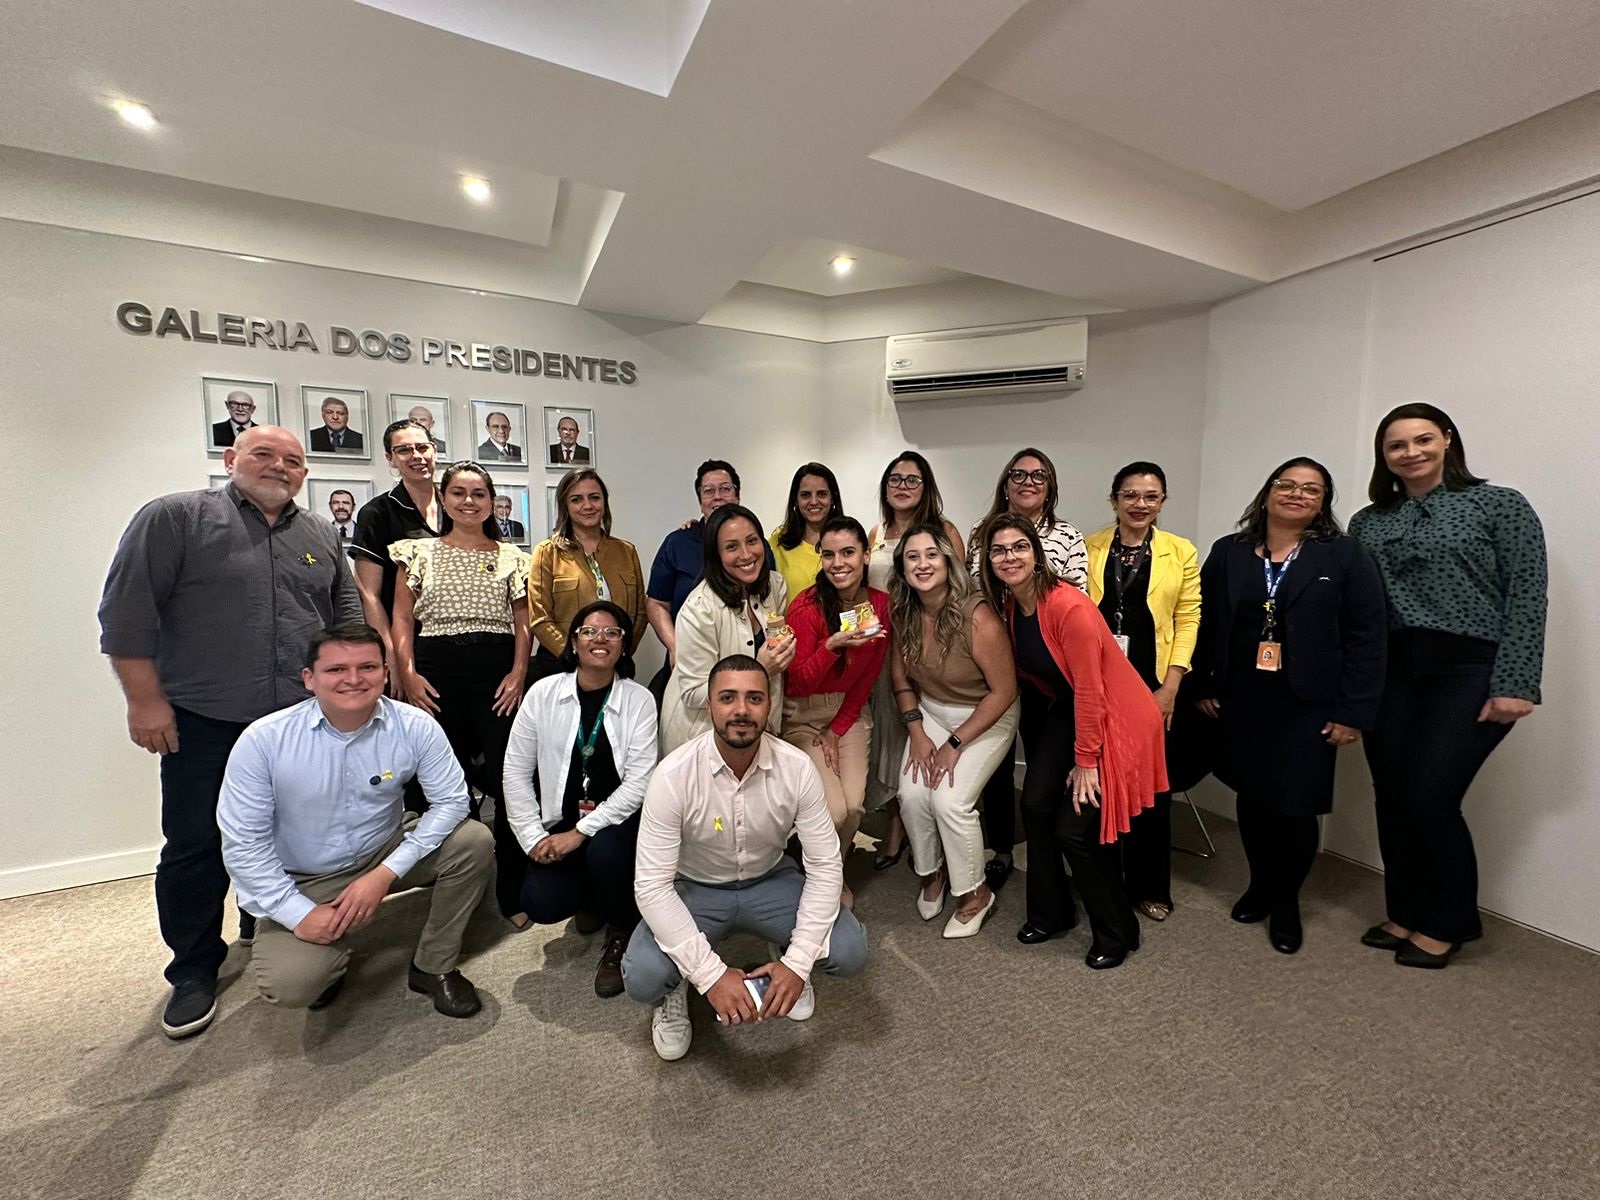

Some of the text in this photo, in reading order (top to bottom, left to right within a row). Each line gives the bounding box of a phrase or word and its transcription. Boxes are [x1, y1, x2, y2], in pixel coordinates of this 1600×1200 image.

[117, 302, 637, 385] GALERIA DOS PRESIDENTES
